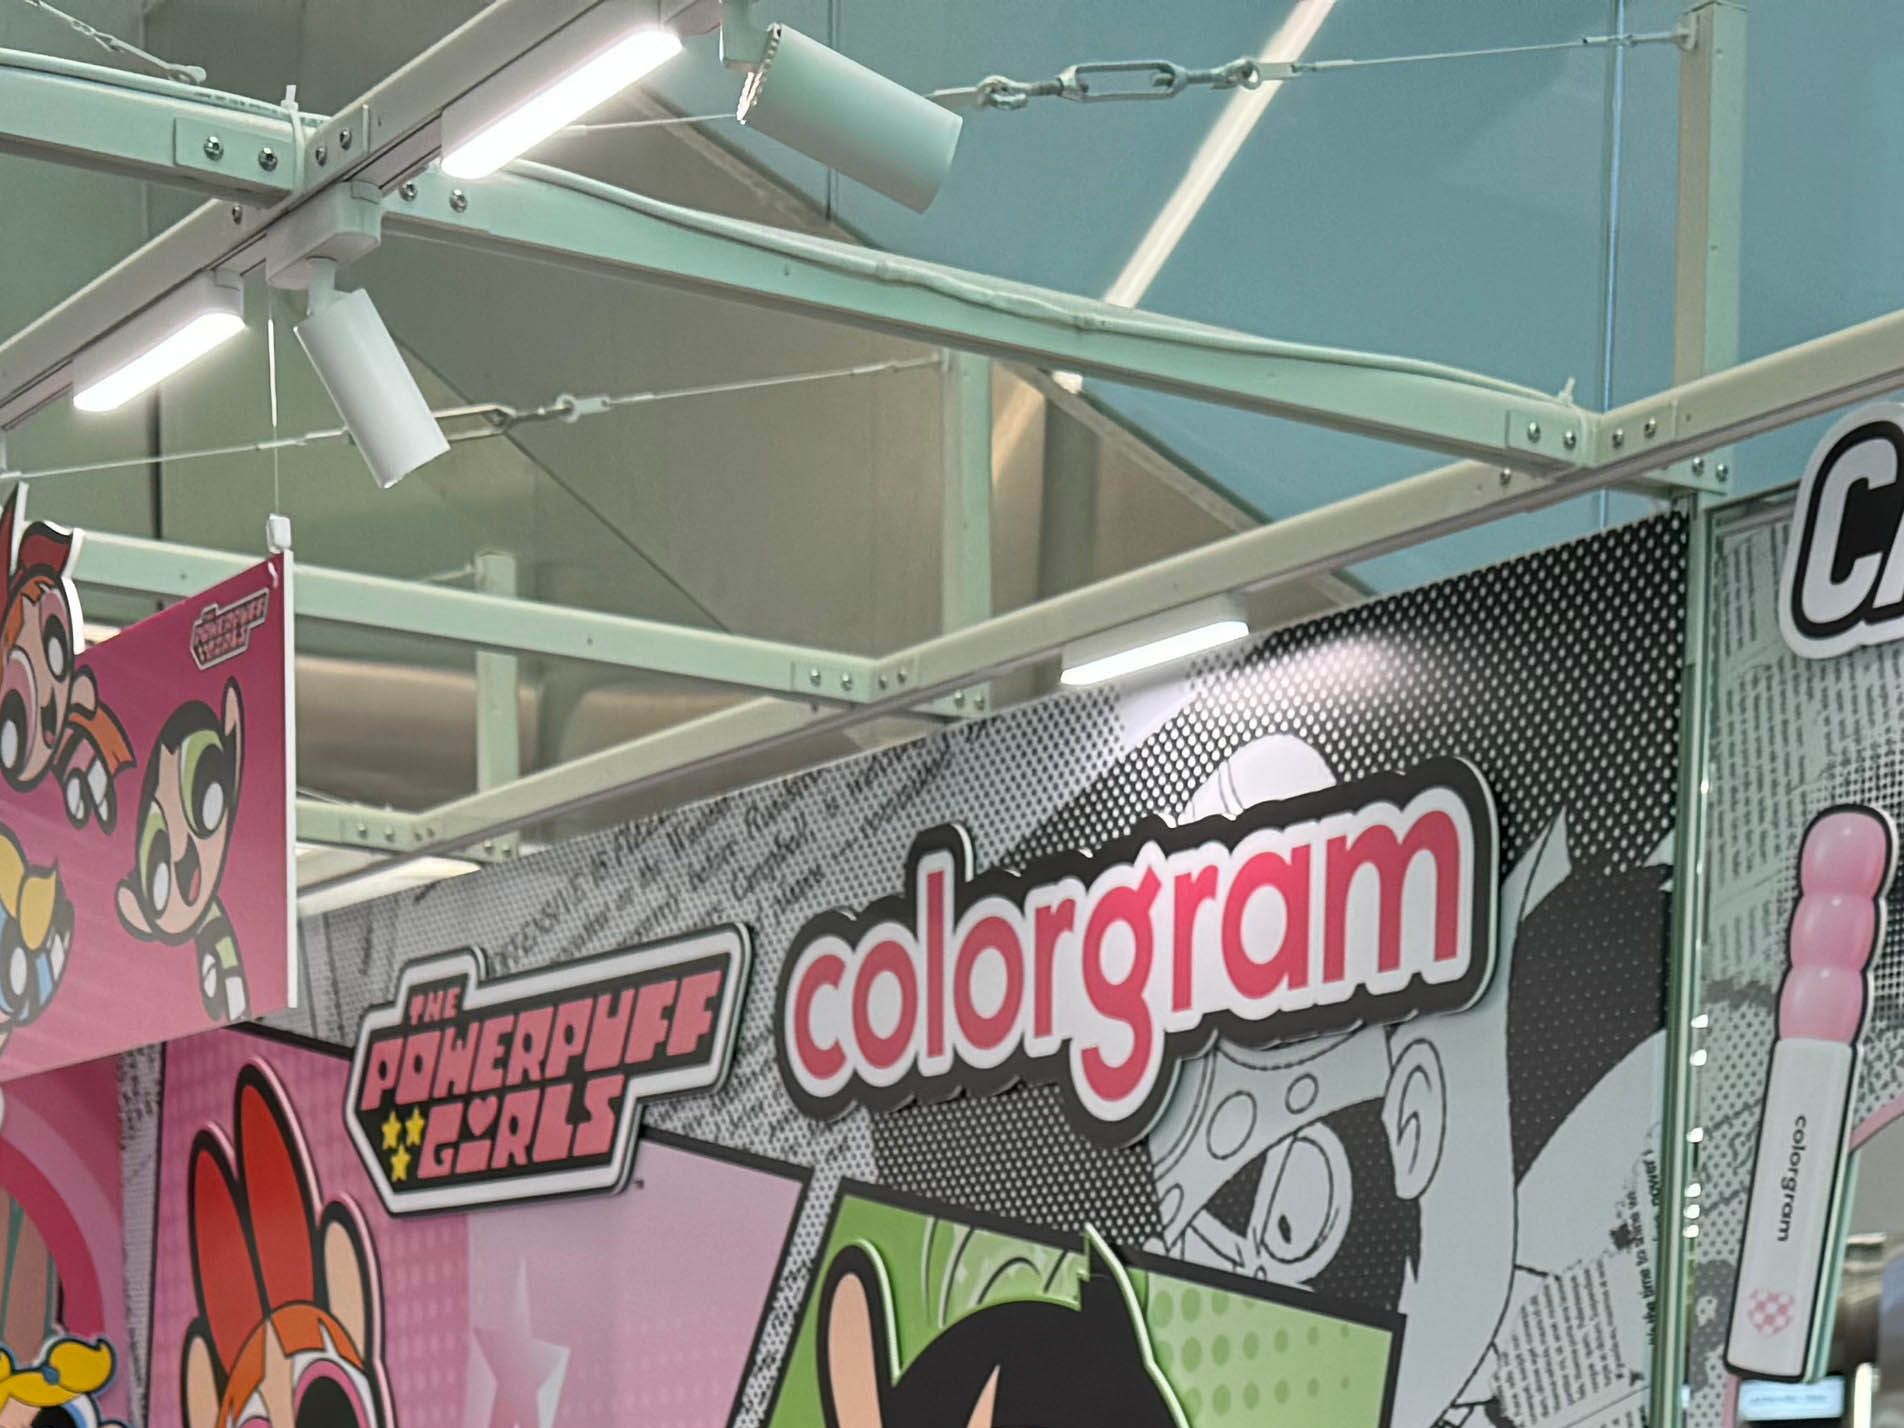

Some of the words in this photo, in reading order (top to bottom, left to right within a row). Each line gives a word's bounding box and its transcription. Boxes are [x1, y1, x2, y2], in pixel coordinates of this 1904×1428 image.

[408, 984, 462, 1024] THE
[794, 801, 1464, 1103] colorgram
[362, 969, 723, 1112] POWERPUFF
[416, 1074, 626, 1180] GIRLS
[1776, 1113, 1809, 1246] colorgram
